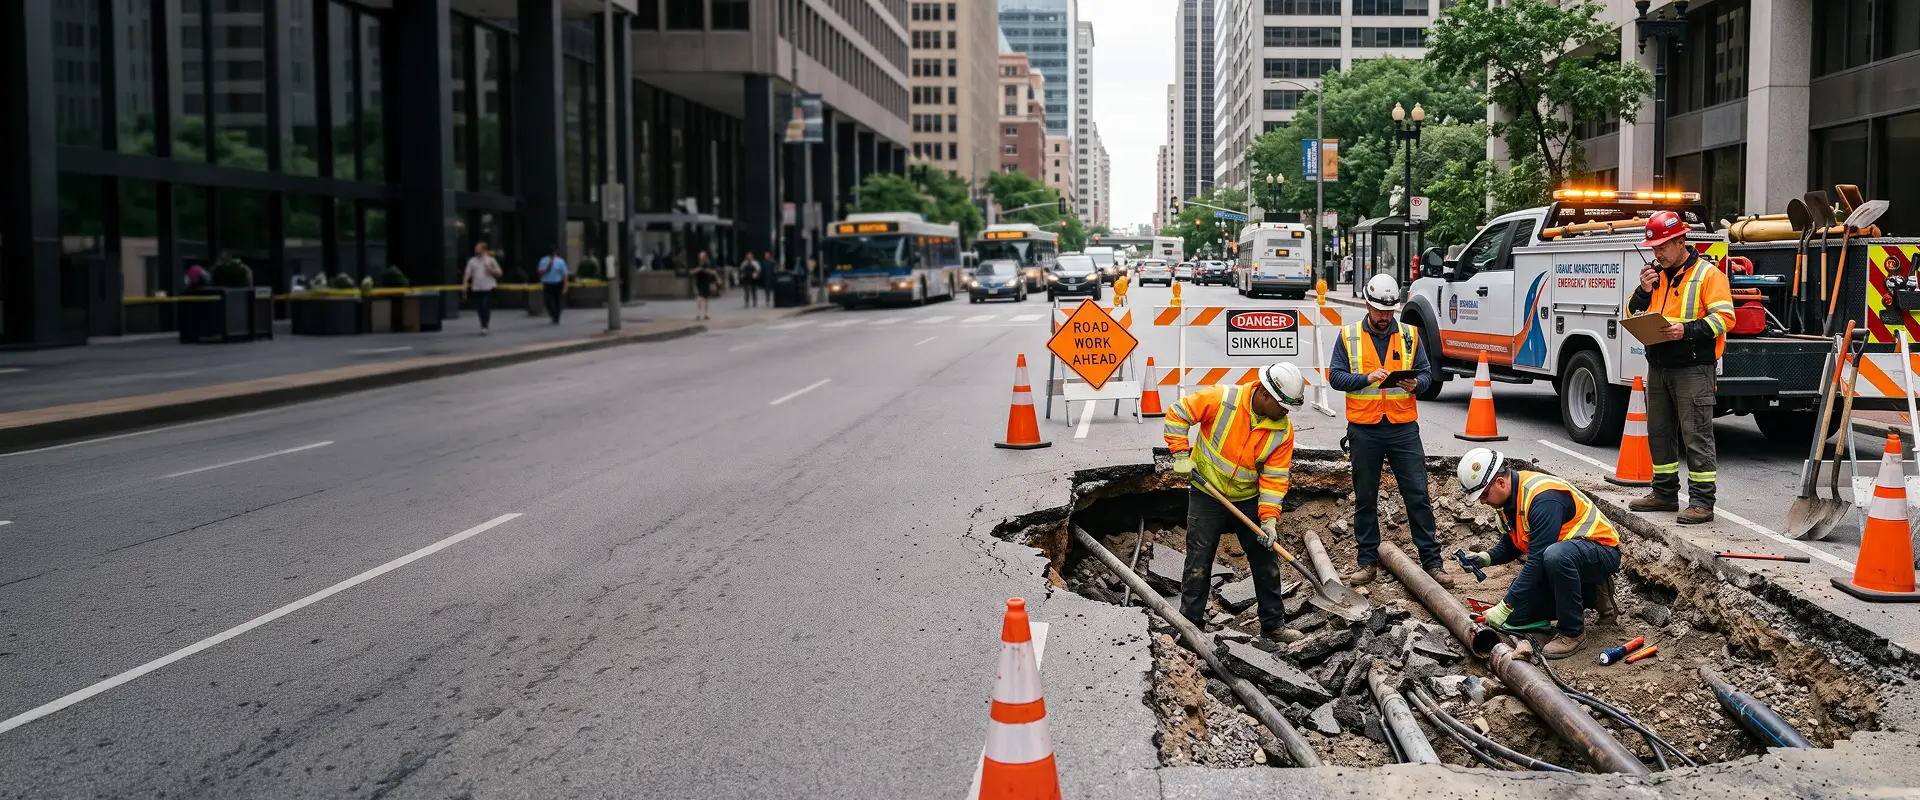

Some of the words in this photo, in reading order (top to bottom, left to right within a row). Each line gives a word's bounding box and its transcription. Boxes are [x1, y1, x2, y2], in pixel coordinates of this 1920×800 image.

[1073, 321, 1110, 333] ROAD
[1237, 315, 1287, 327] DANGER
[1074, 337, 1112, 349] WORK
[1231, 337, 1294, 349] SINKHOLE
[1072, 353, 1118, 366] AHEAD
